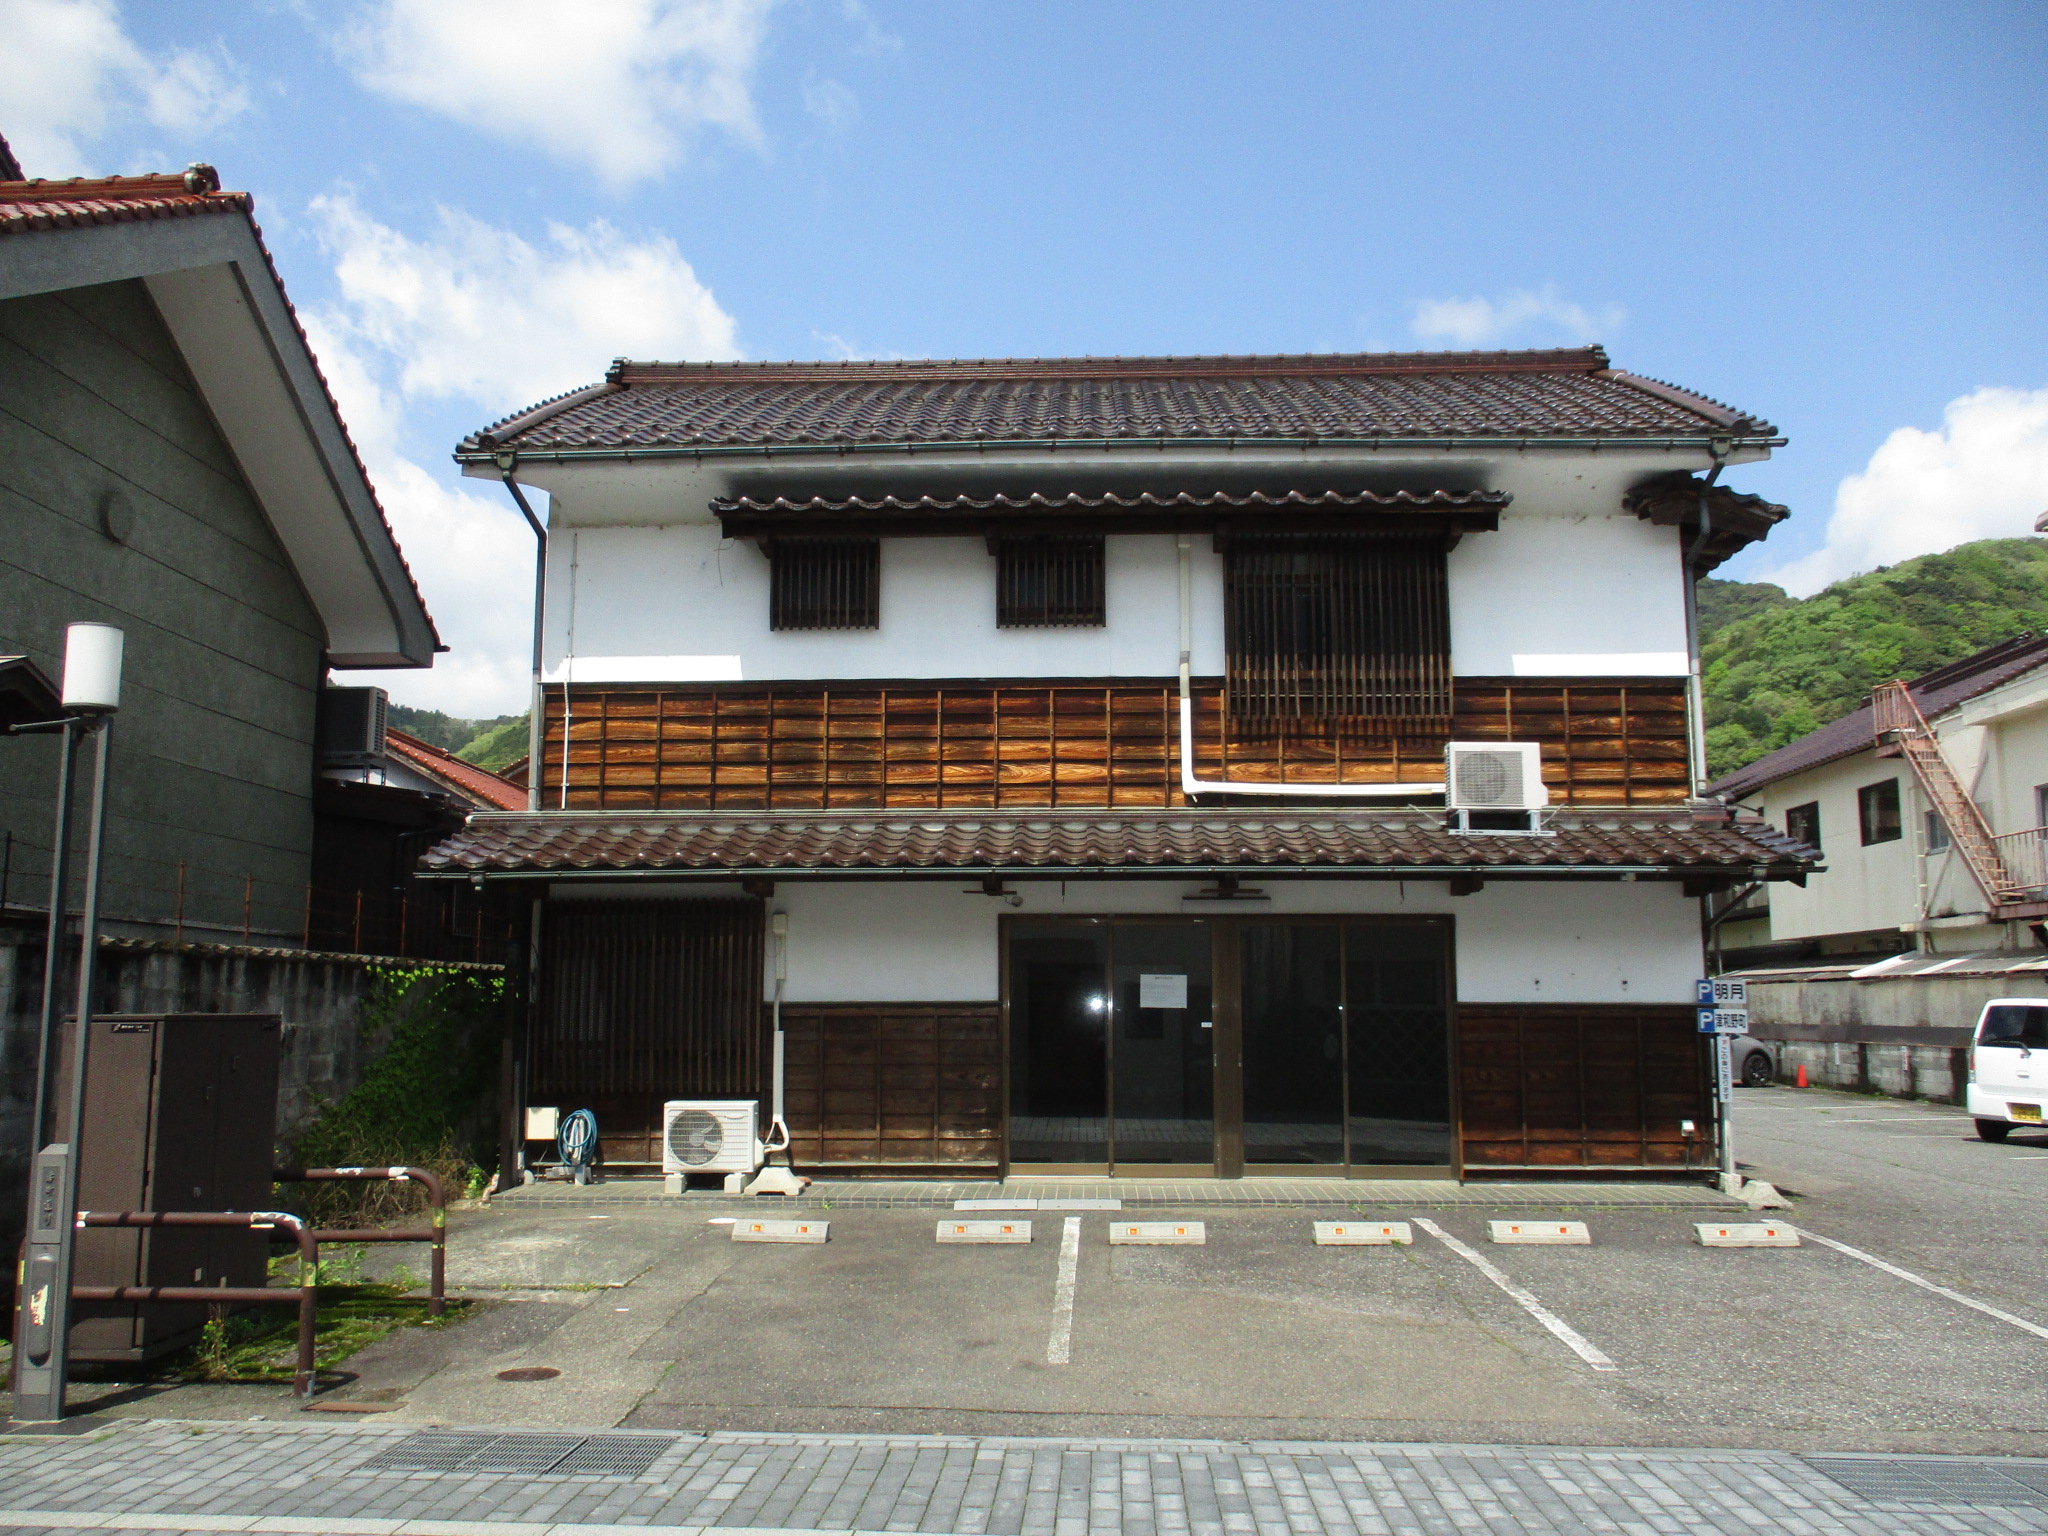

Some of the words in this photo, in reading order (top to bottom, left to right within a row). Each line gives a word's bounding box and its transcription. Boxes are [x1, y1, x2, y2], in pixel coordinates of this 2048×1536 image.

[1698, 983, 1711, 1000] P
[1714, 983, 1743, 1000] 明月
[1700, 1012, 1713, 1029] P
